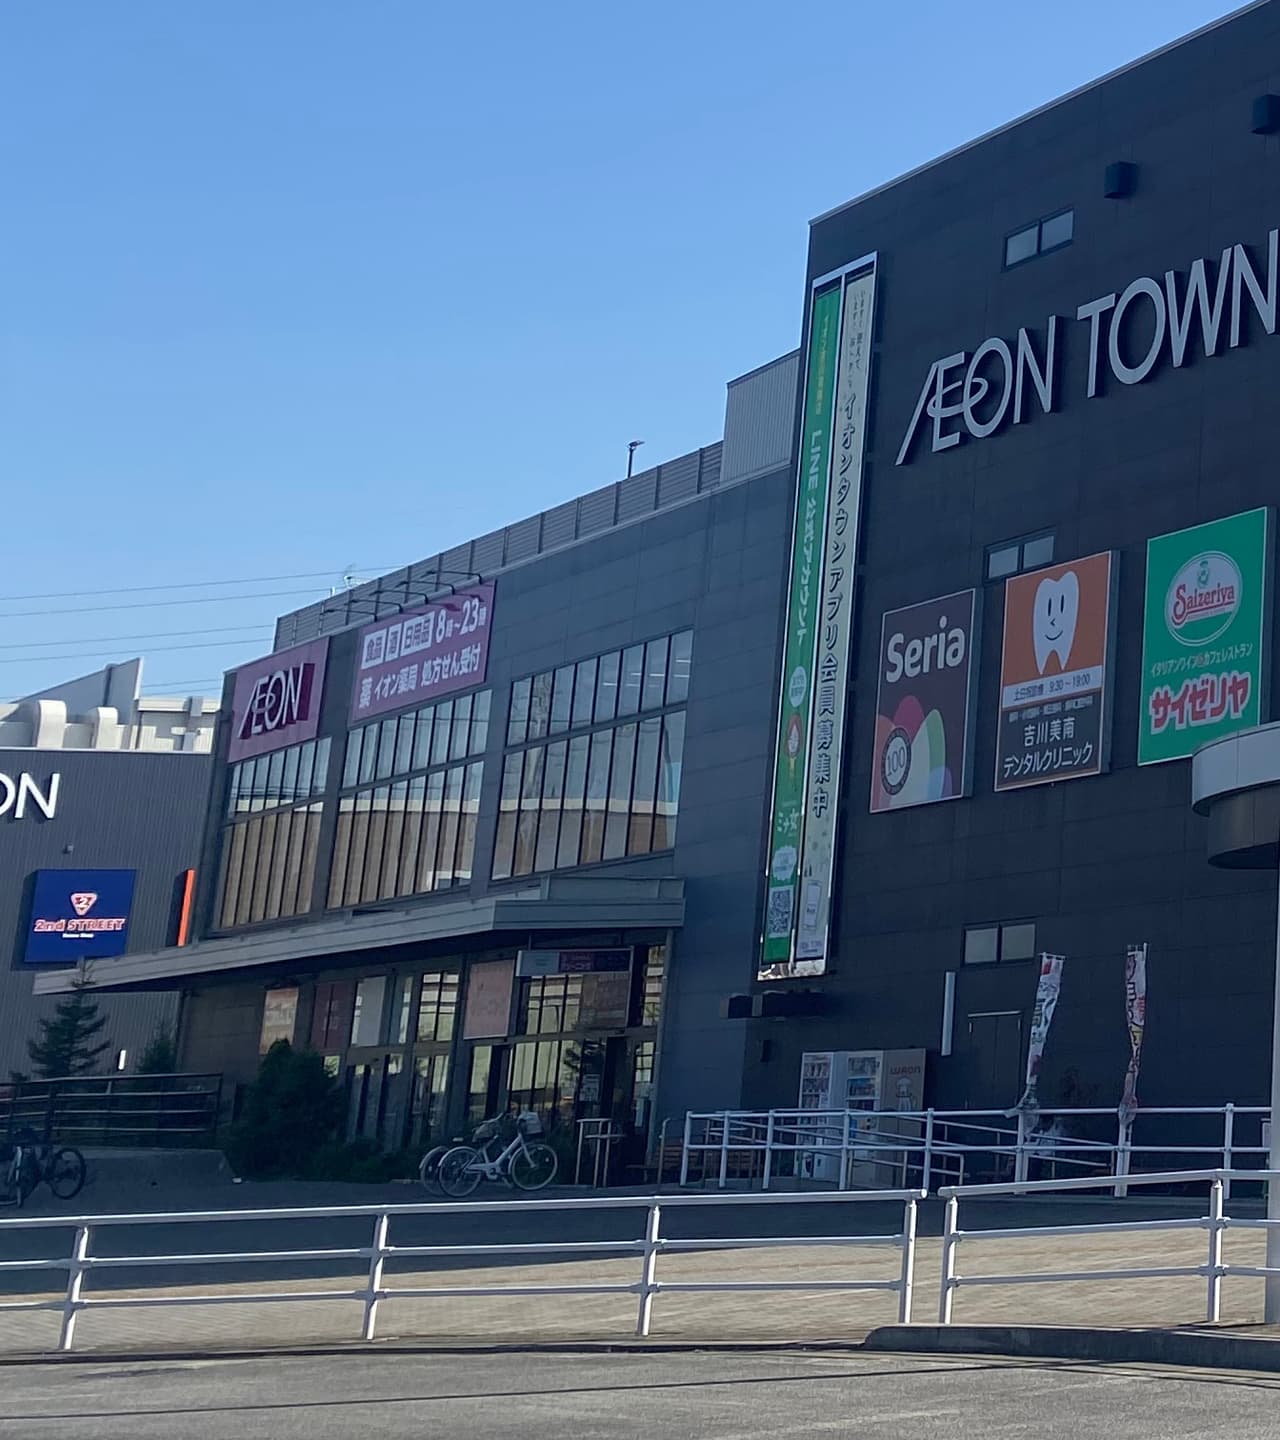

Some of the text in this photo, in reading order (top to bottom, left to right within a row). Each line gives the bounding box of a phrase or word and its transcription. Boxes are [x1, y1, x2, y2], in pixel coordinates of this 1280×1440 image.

[808, 428, 823, 492] LINE
[812, 392, 857, 819] イオンタウンアプリ会員募集中
[1171, 582, 1236, 626] Saizeriya
[885, 615, 966, 684] Seria
[1150, 671, 1252, 734] サイゼリヤ
[1024, 716, 1076, 747] 吉川美南
[1003, 741, 1094, 779] デンタルクリニック
[34, 918, 126, 932] 2nd STREET
